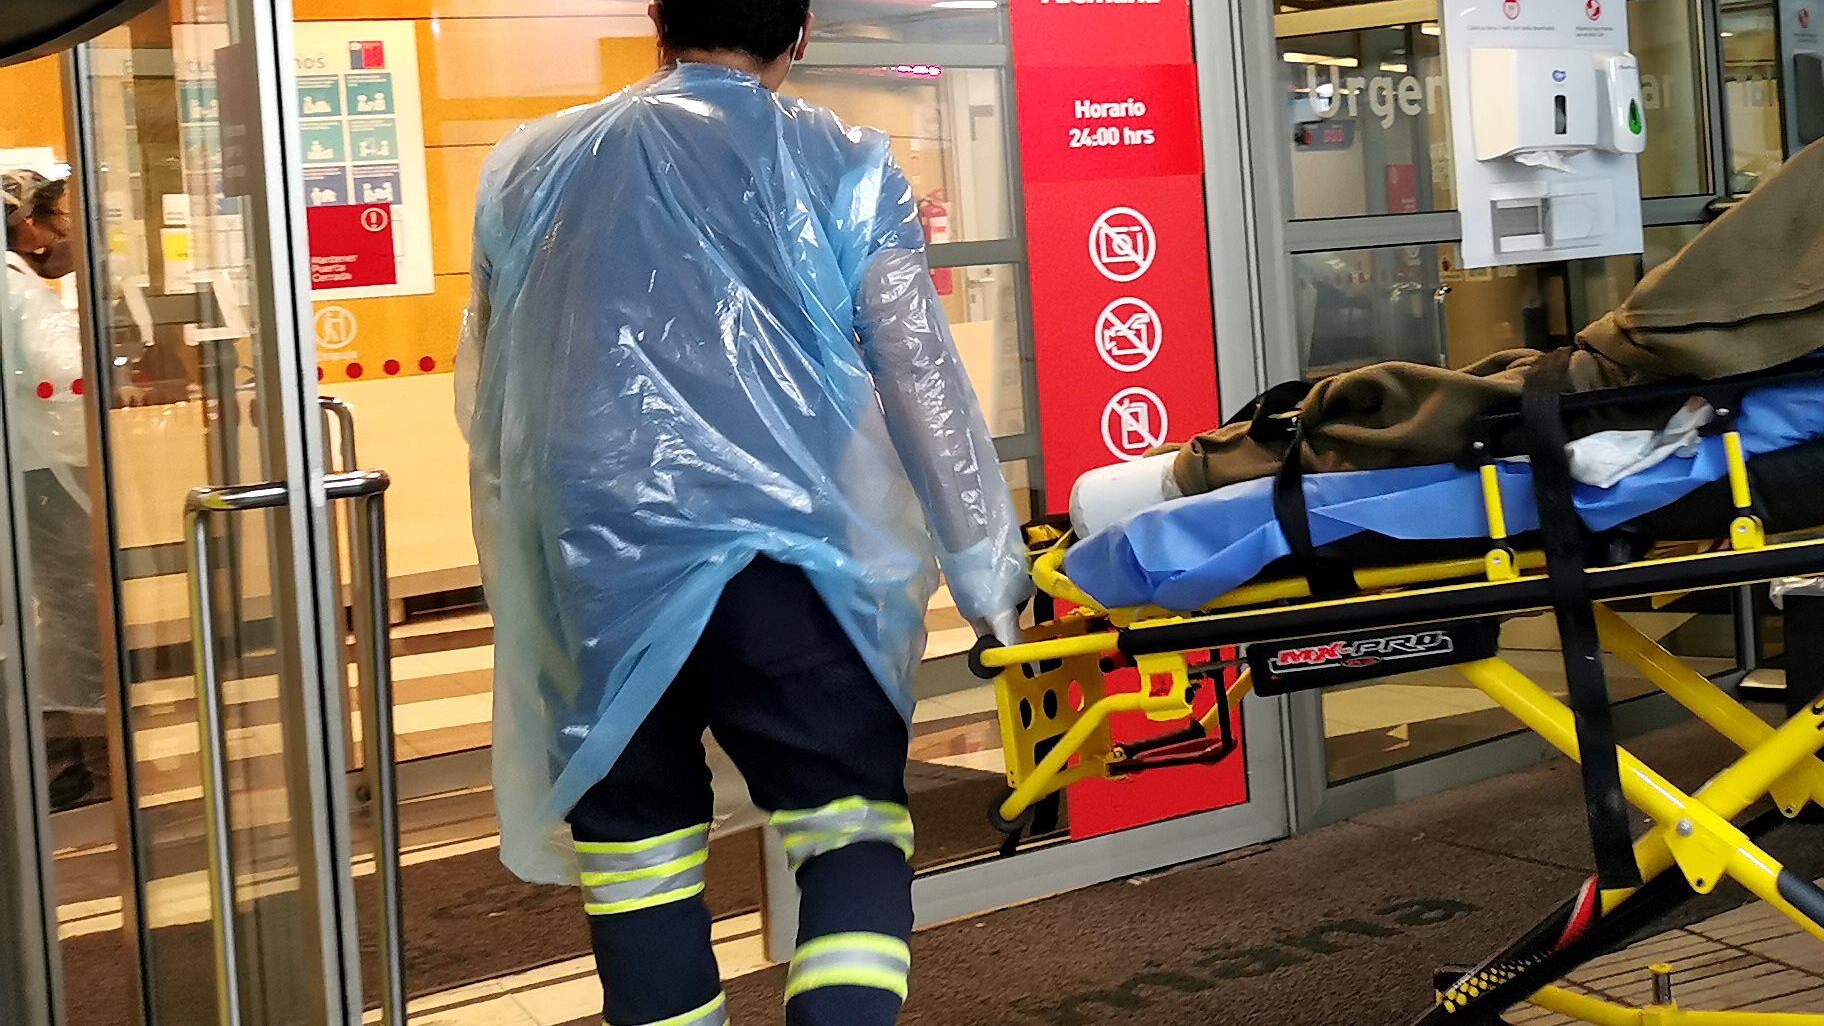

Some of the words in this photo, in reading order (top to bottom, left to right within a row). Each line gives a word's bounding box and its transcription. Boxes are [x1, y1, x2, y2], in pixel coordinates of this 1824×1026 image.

[1074, 97, 1147, 119] Horario
[1306, 63, 1443, 129] Urgen
[1068, 126, 1120, 148] 24:00
[1123, 126, 1156, 146] hrs
[1278, 630, 1448, 666] MX-PRO
